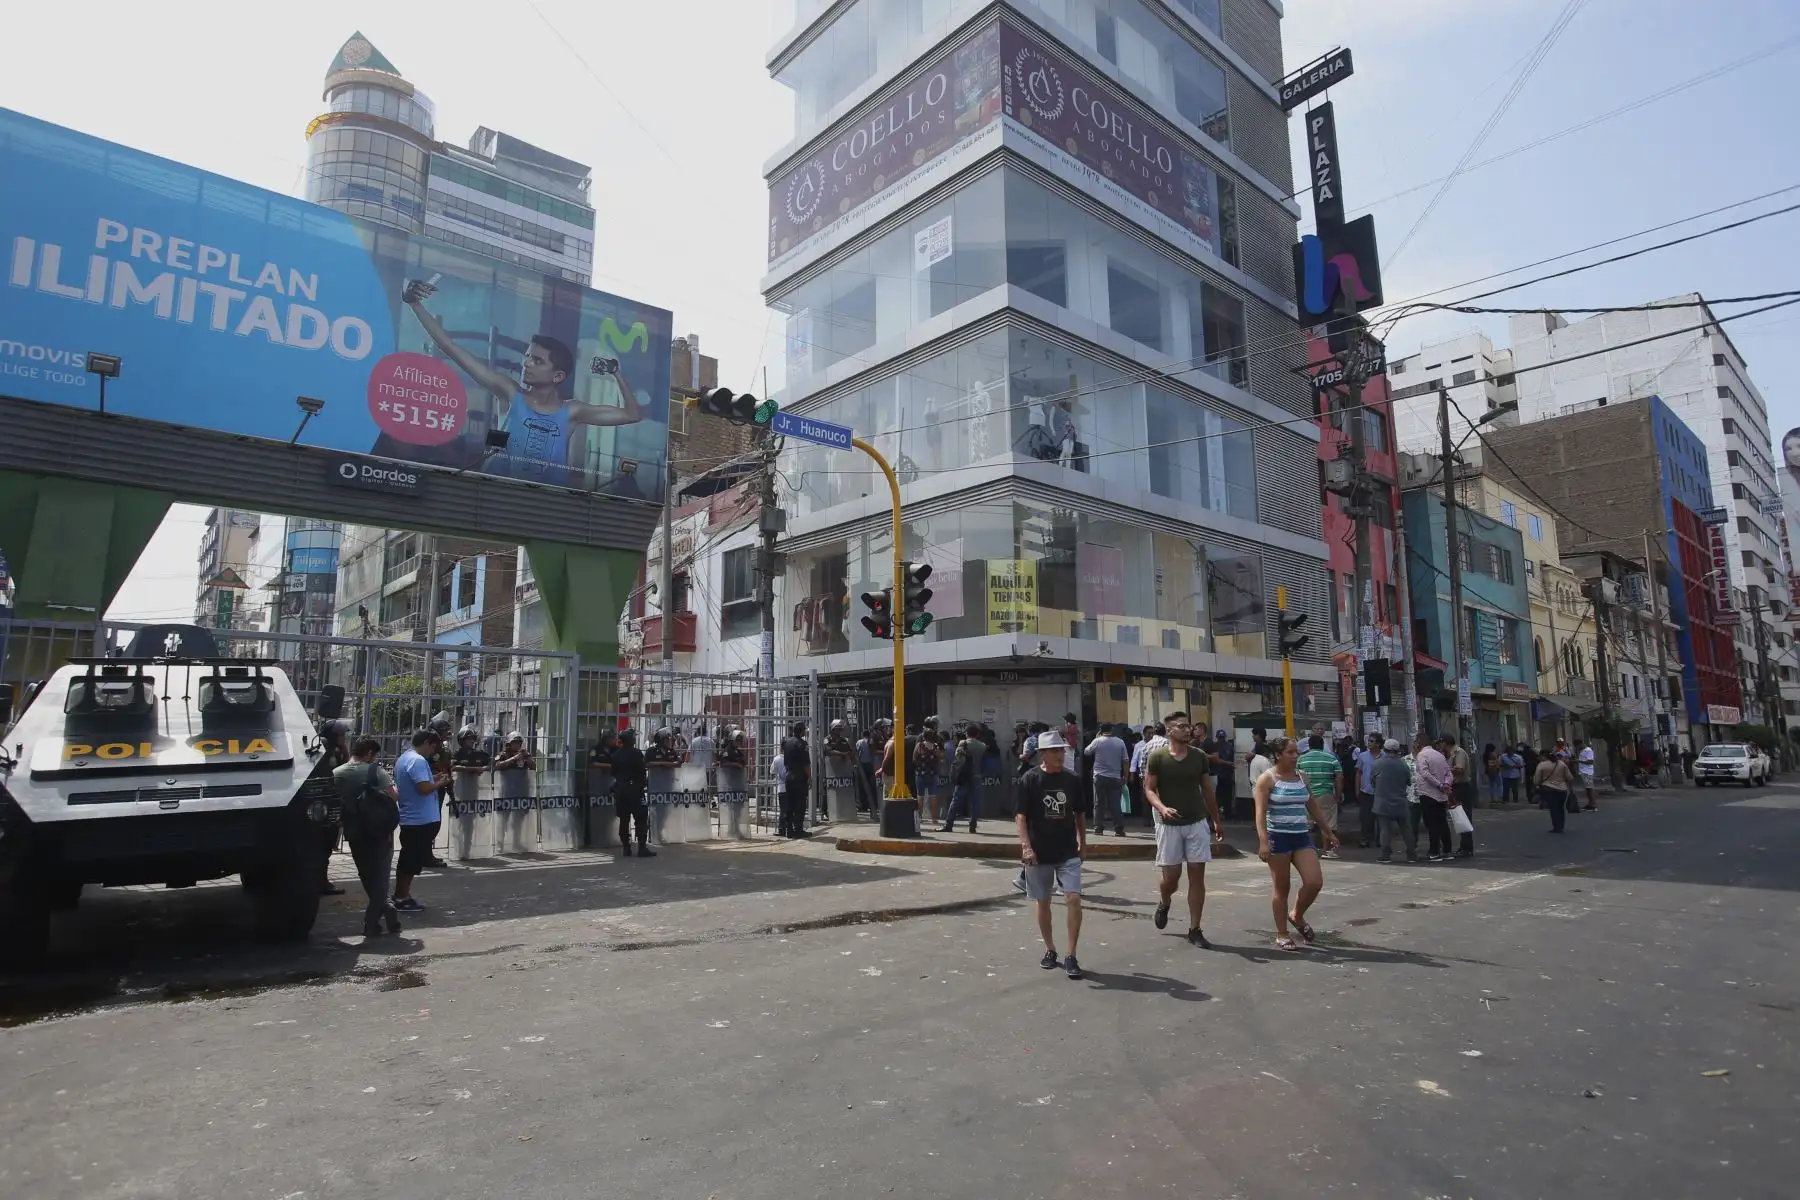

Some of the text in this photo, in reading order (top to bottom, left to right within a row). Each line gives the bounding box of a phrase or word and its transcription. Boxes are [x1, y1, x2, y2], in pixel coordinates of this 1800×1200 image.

[1282, 58, 1345, 100] GALERIA
[832, 73, 947, 172] COELLO
[1072, 87, 1172, 174] COELLO
[832, 110, 946, 196] ABOGADOS
[1073, 122, 1174, 195] ABOGADOS
[1311, 116, 1334, 204] PLAZA
[95, 218, 318, 301] PREPLAN
[10, 236, 373, 360] ILIMITADO
[44, 369, 86, 386] TODO
[393, 365, 448, 389] Afíliate
[1312, 370, 1343, 388] 1705
[379, 382, 459, 408] marcando
[778, 416, 847, 444] Jr. Huanuco
[361, 465, 417, 484] Dardos
[63, 738, 277, 761] POLCIA
[456, 801, 492, 815] OLICIA
[495, 798, 537, 811] POLICIA
[541, 797, 580, 809] POLICIA
[589, 796, 615, 808] POLI
